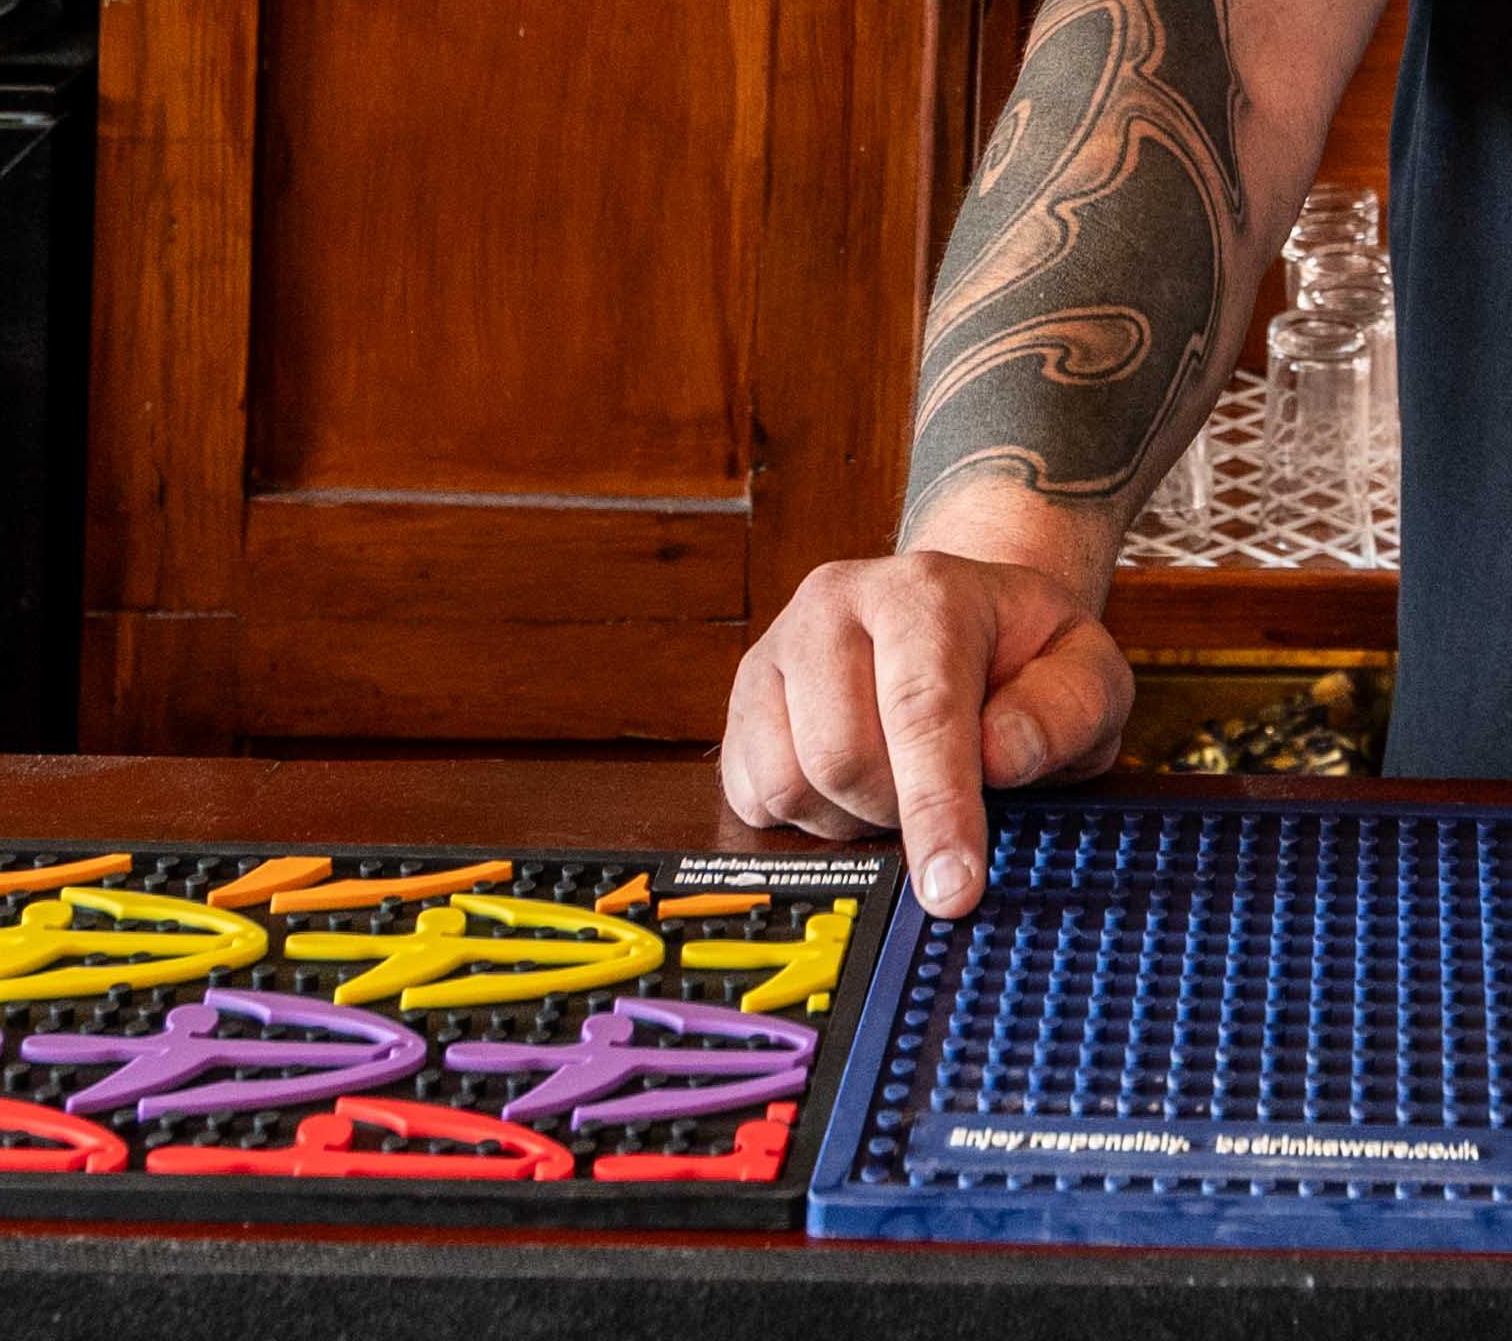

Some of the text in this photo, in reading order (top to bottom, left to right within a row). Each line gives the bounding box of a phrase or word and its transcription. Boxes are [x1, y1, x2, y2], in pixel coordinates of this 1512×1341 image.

[674, 873, 877, 885] ENJOY RESPONSIBLY
[950, 1126, 1023, 1151] Enjoy
[1215, 1133, 1479, 1162] bedrinkaware.co.uk
